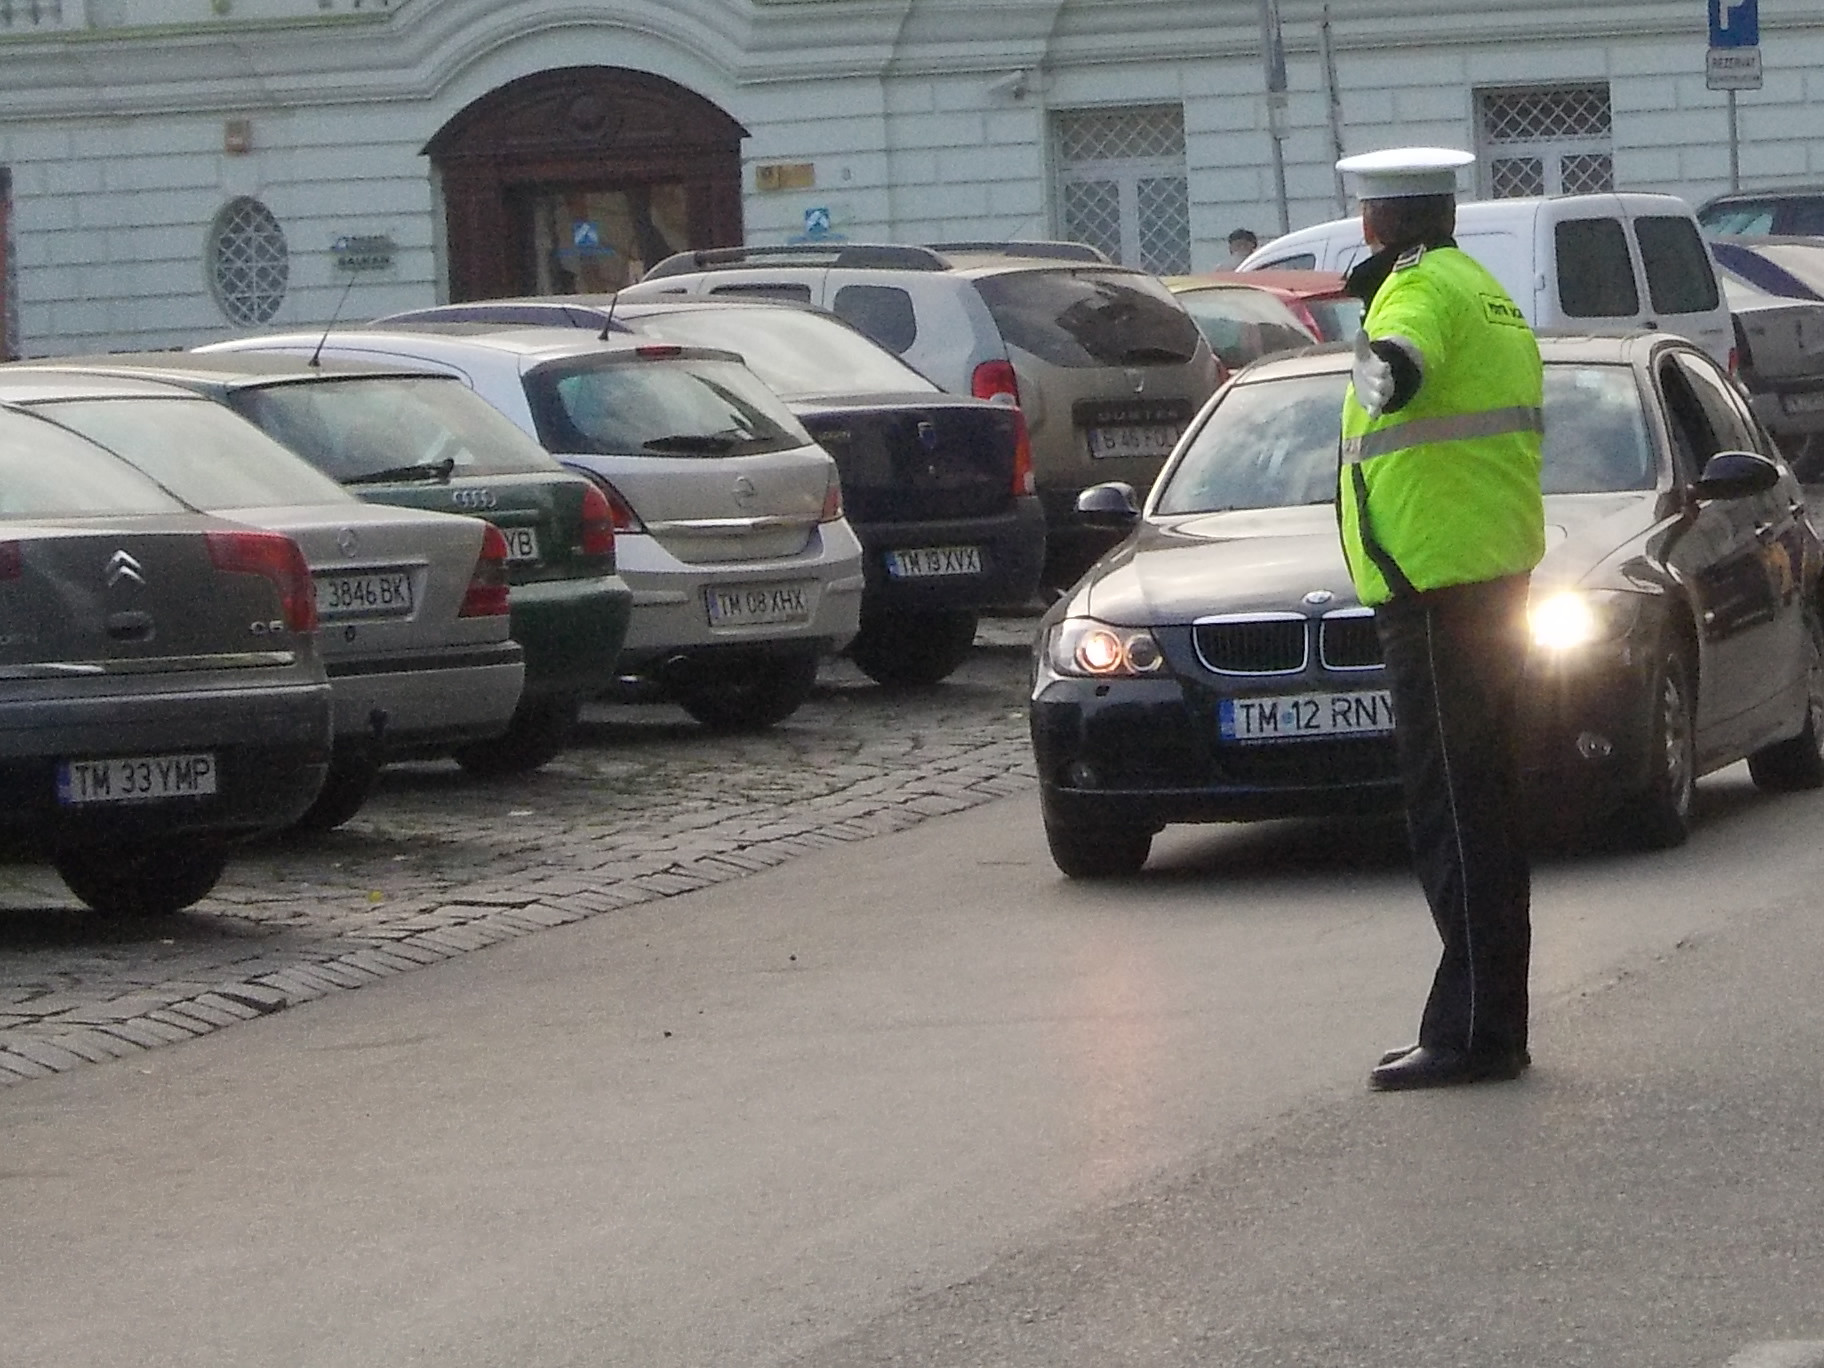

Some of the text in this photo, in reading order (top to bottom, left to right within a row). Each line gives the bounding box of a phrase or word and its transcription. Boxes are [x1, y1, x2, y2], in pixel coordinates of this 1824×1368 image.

[718, 593, 743, 617] TM
[1239, 702, 1280, 734] TM
[1291, 699, 1321, 731] 12
[75, 757, 211, 796] TM 33 YMP
